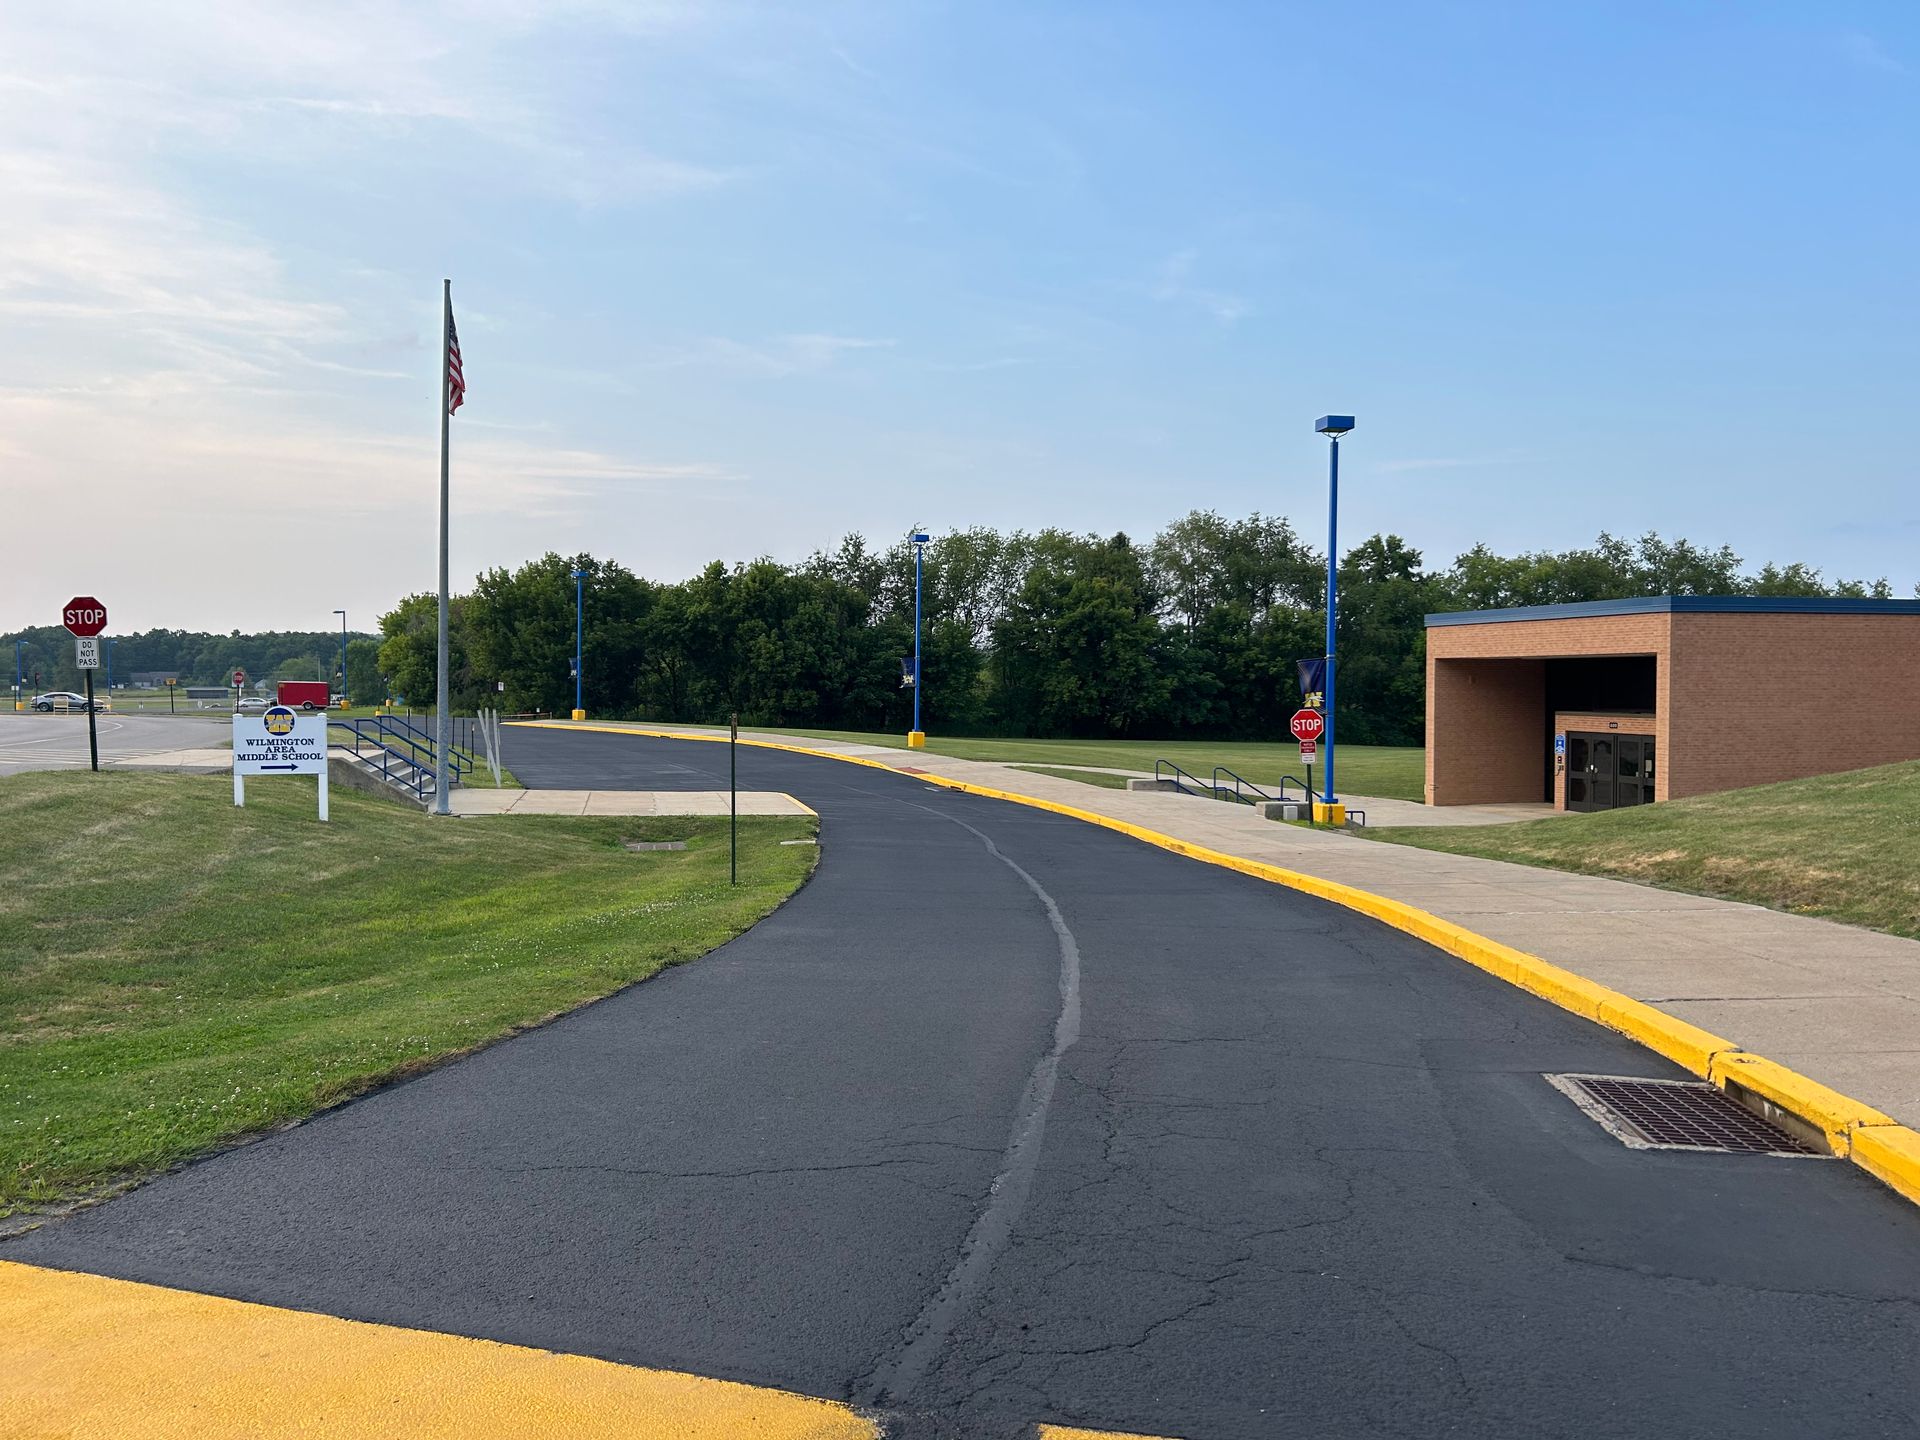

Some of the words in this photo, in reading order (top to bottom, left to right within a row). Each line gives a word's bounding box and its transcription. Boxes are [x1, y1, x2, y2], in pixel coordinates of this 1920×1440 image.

[66, 609, 104, 625] STOP
[82, 641, 92, 649] DO
[79, 658, 97, 666] PASS
[1293, 719, 1321, 731] STOP
[245, 738, 315, 746] WILMINGTON
[237, 753, 278, 761] MIDDLE
[281, 752, 323, 760] SCHOOL
